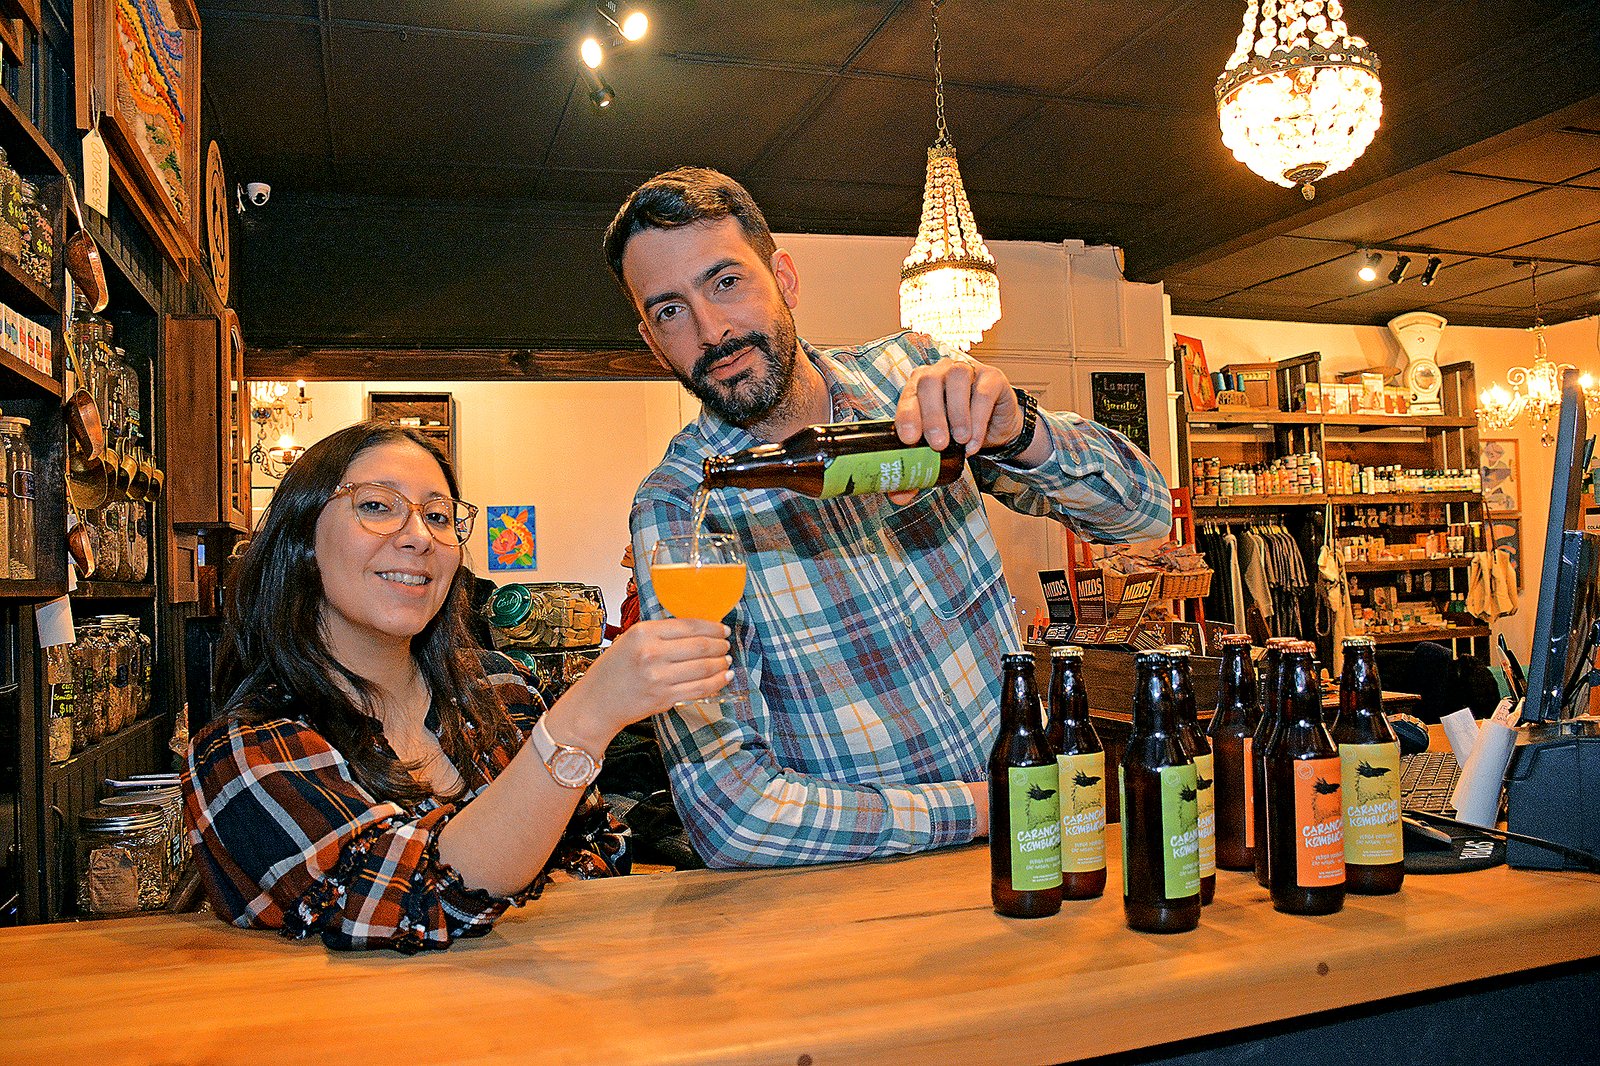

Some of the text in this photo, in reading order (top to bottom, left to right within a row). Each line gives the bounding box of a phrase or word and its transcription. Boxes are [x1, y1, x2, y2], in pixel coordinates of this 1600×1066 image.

[1043, 579, 1068, 598] MIZOS
[1077, 578, 1103, 598] MIZOS
[1122, 580, 1153, 601] MIZOS
